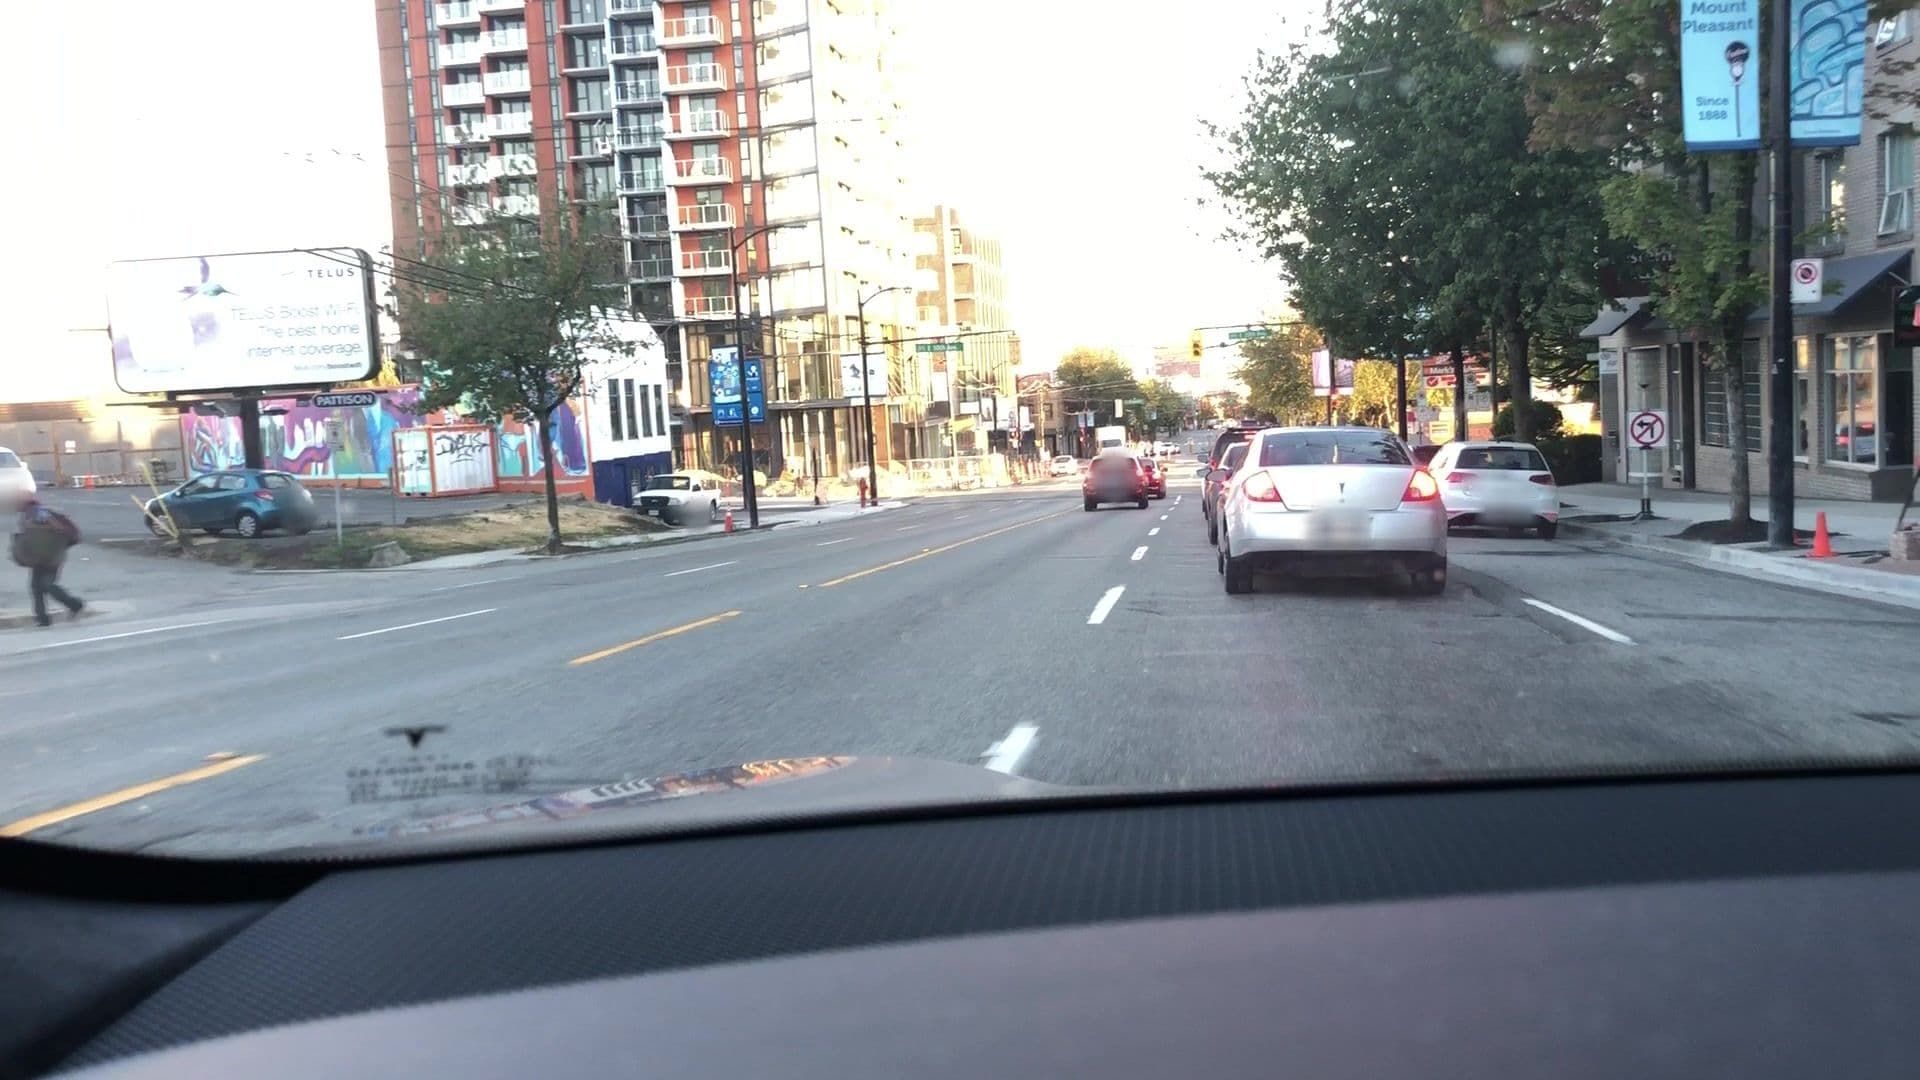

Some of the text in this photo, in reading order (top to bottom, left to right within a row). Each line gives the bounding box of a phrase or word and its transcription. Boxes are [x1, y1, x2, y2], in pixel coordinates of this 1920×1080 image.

[1691, 0, 1747, 15] Mount
[1683, 18, 1752, 33] Pleasant
[1695, 96, 1729, 107] Since
[1698, 110, 1728, 121] 1888
[307, 267, 355, 279] TELUS
[287, 323, 317, 337] best
[321, 320, 360, 335] home
[244, 343, 295, 358] nternet
[316, 394, 373, 406] PATTISON
